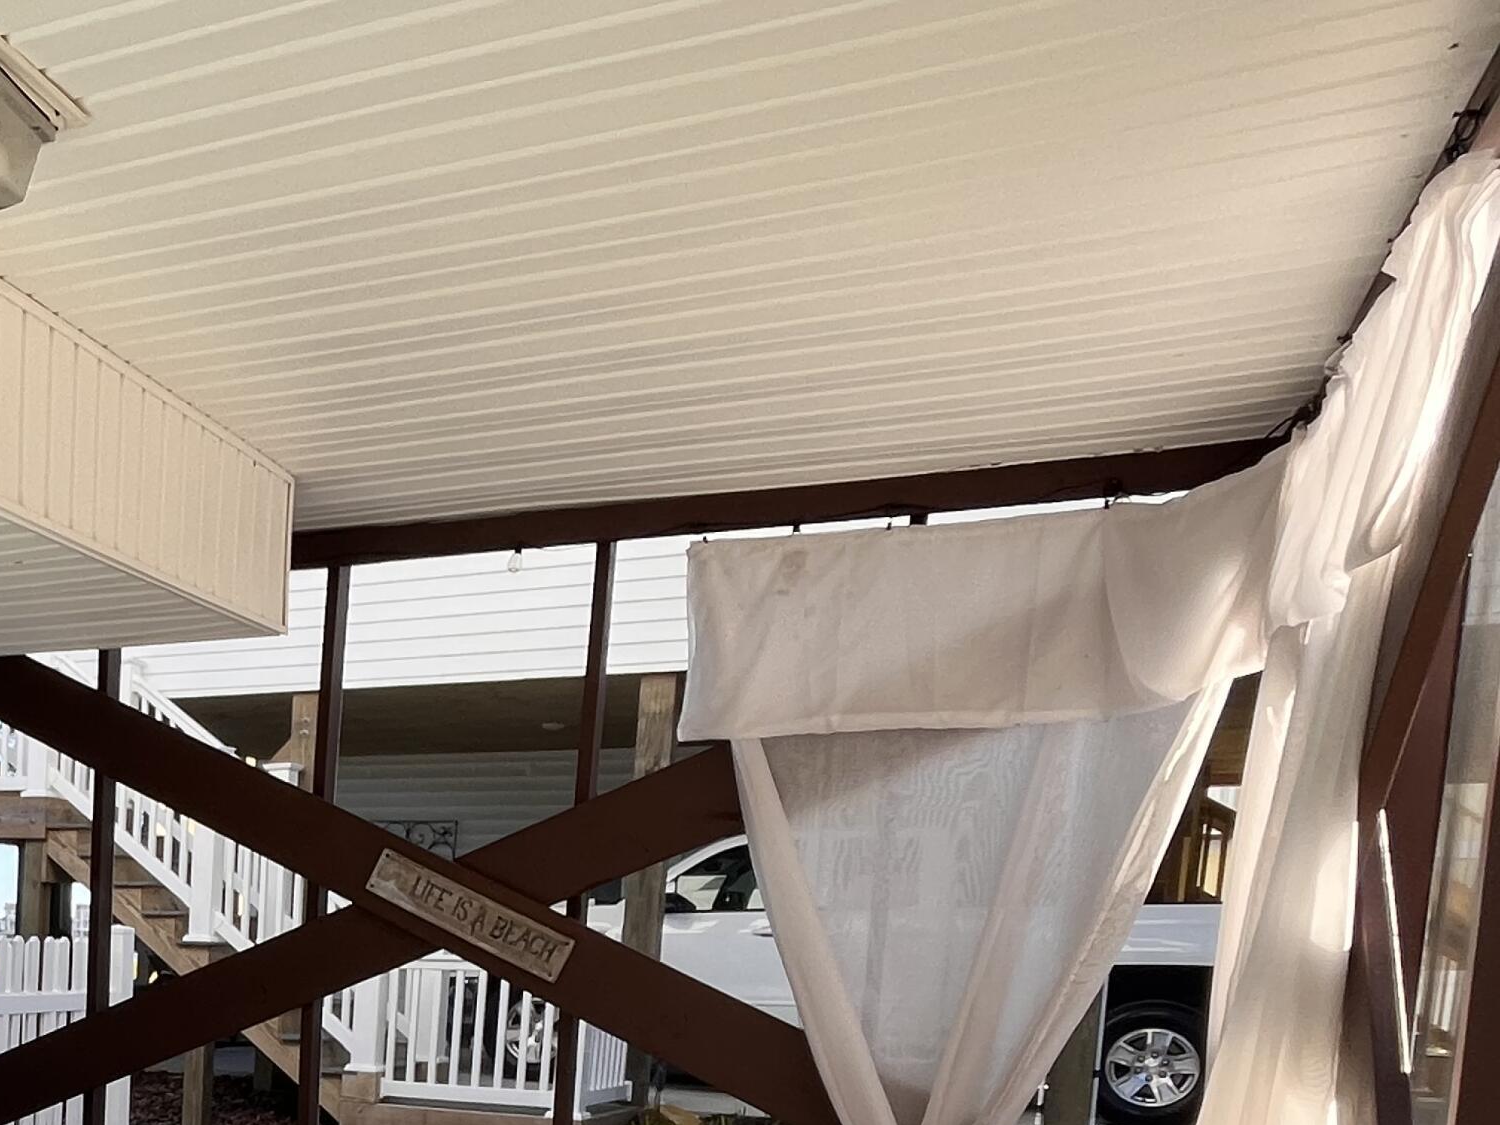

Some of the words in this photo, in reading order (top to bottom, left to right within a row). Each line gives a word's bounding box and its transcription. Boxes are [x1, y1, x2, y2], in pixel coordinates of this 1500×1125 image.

[411, 877, 452, 911] LIFE
[453, 896, 472, 921] IS
[470, 904, 487, 936] A
[491, 916, 558, 964] BEACH
